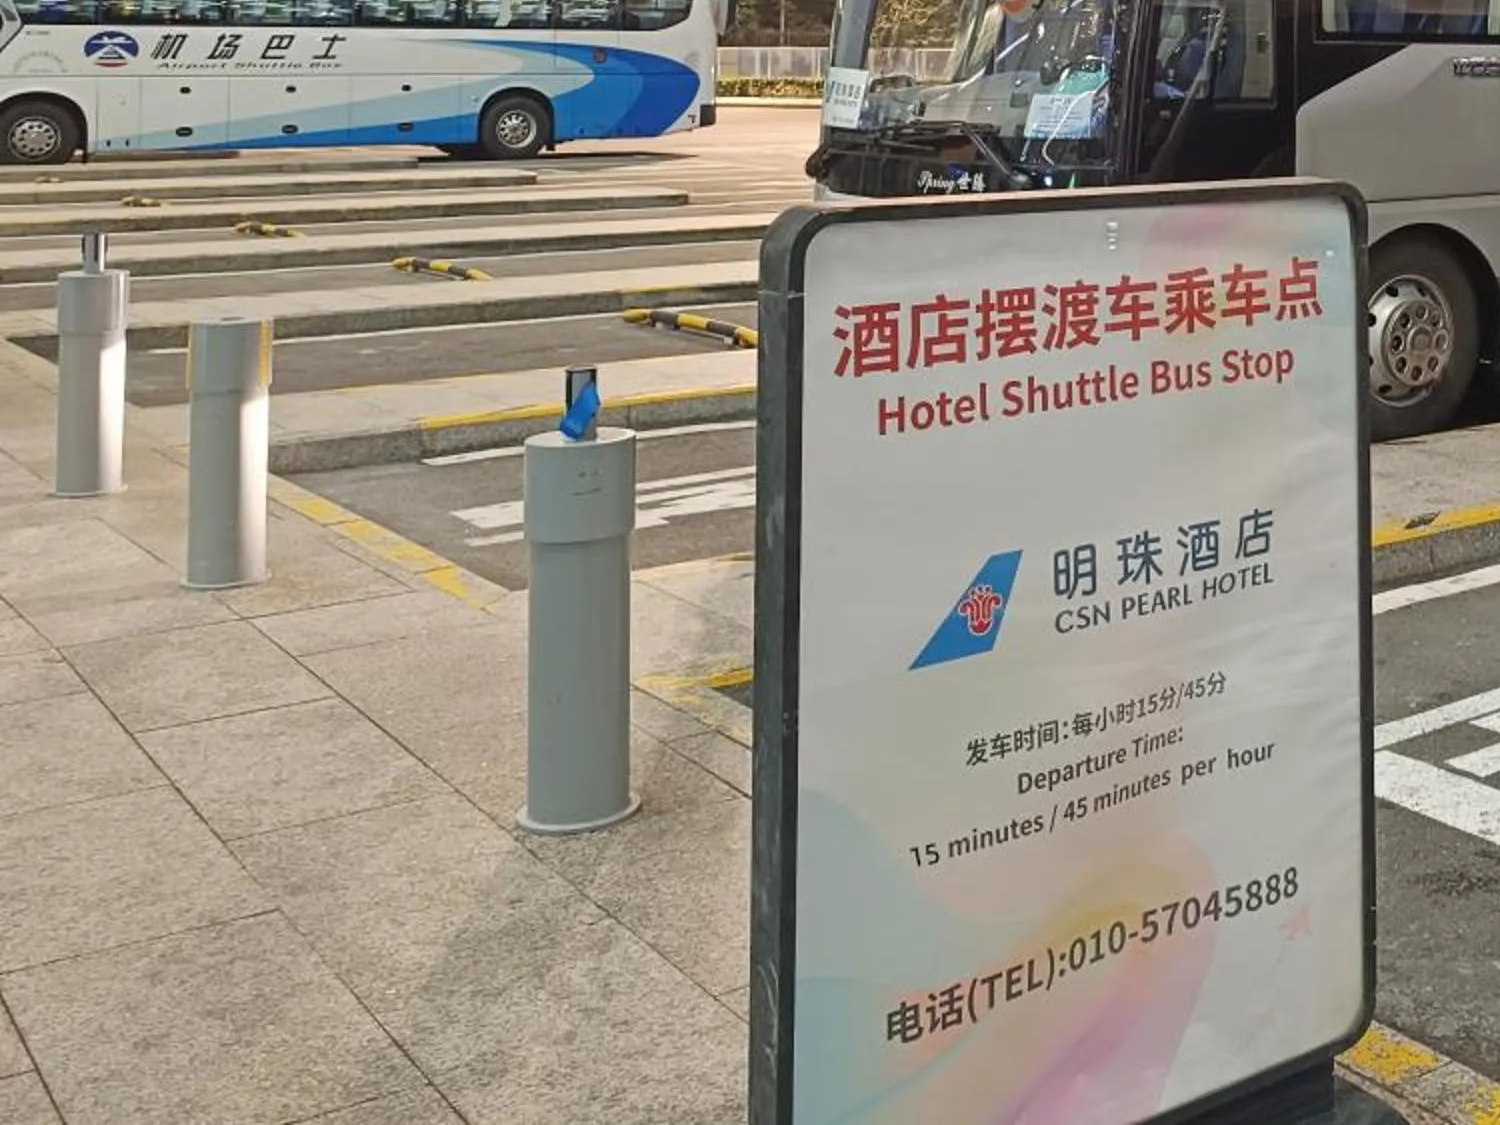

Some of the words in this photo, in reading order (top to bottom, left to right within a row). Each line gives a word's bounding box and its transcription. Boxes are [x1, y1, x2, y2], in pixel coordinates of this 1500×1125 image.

[150, 32, 347, 60] 机场巴士
[158, 62, 226, 70] Airport
[235, 61, 302, 69] Shuttle
[832, 256, 1324, 378] 酒店摆渡车乘车点
[878, 382, 990, 435] Hotel
[1002, 365, 1139, 418] Shuttle
[1150, 359, 1211, 395] Bus
[1221, 347, 1294, 384] Stop
[1053, 508, 1274, 600] 明珠酒店
[1054, 600, 1111, 634] CSN
[1121, 583, 1193, 620] PEARL
[1202, 562, 1274, 600] HOTEL
[1017, 745, 1127, 795] Departure
[1131, 726, 1184, 759] Time:
[909, 842, 941, 868] 15
[948, 813, 1045, 859] minutes
[1048, 804, 1059, 834] /
[1062, 796, 1089, 823] 45
[1092, 767, 1172, 814] minutes
[1180, 756, 1218, 786] per
[1226, 740, 1276, 771] hour
